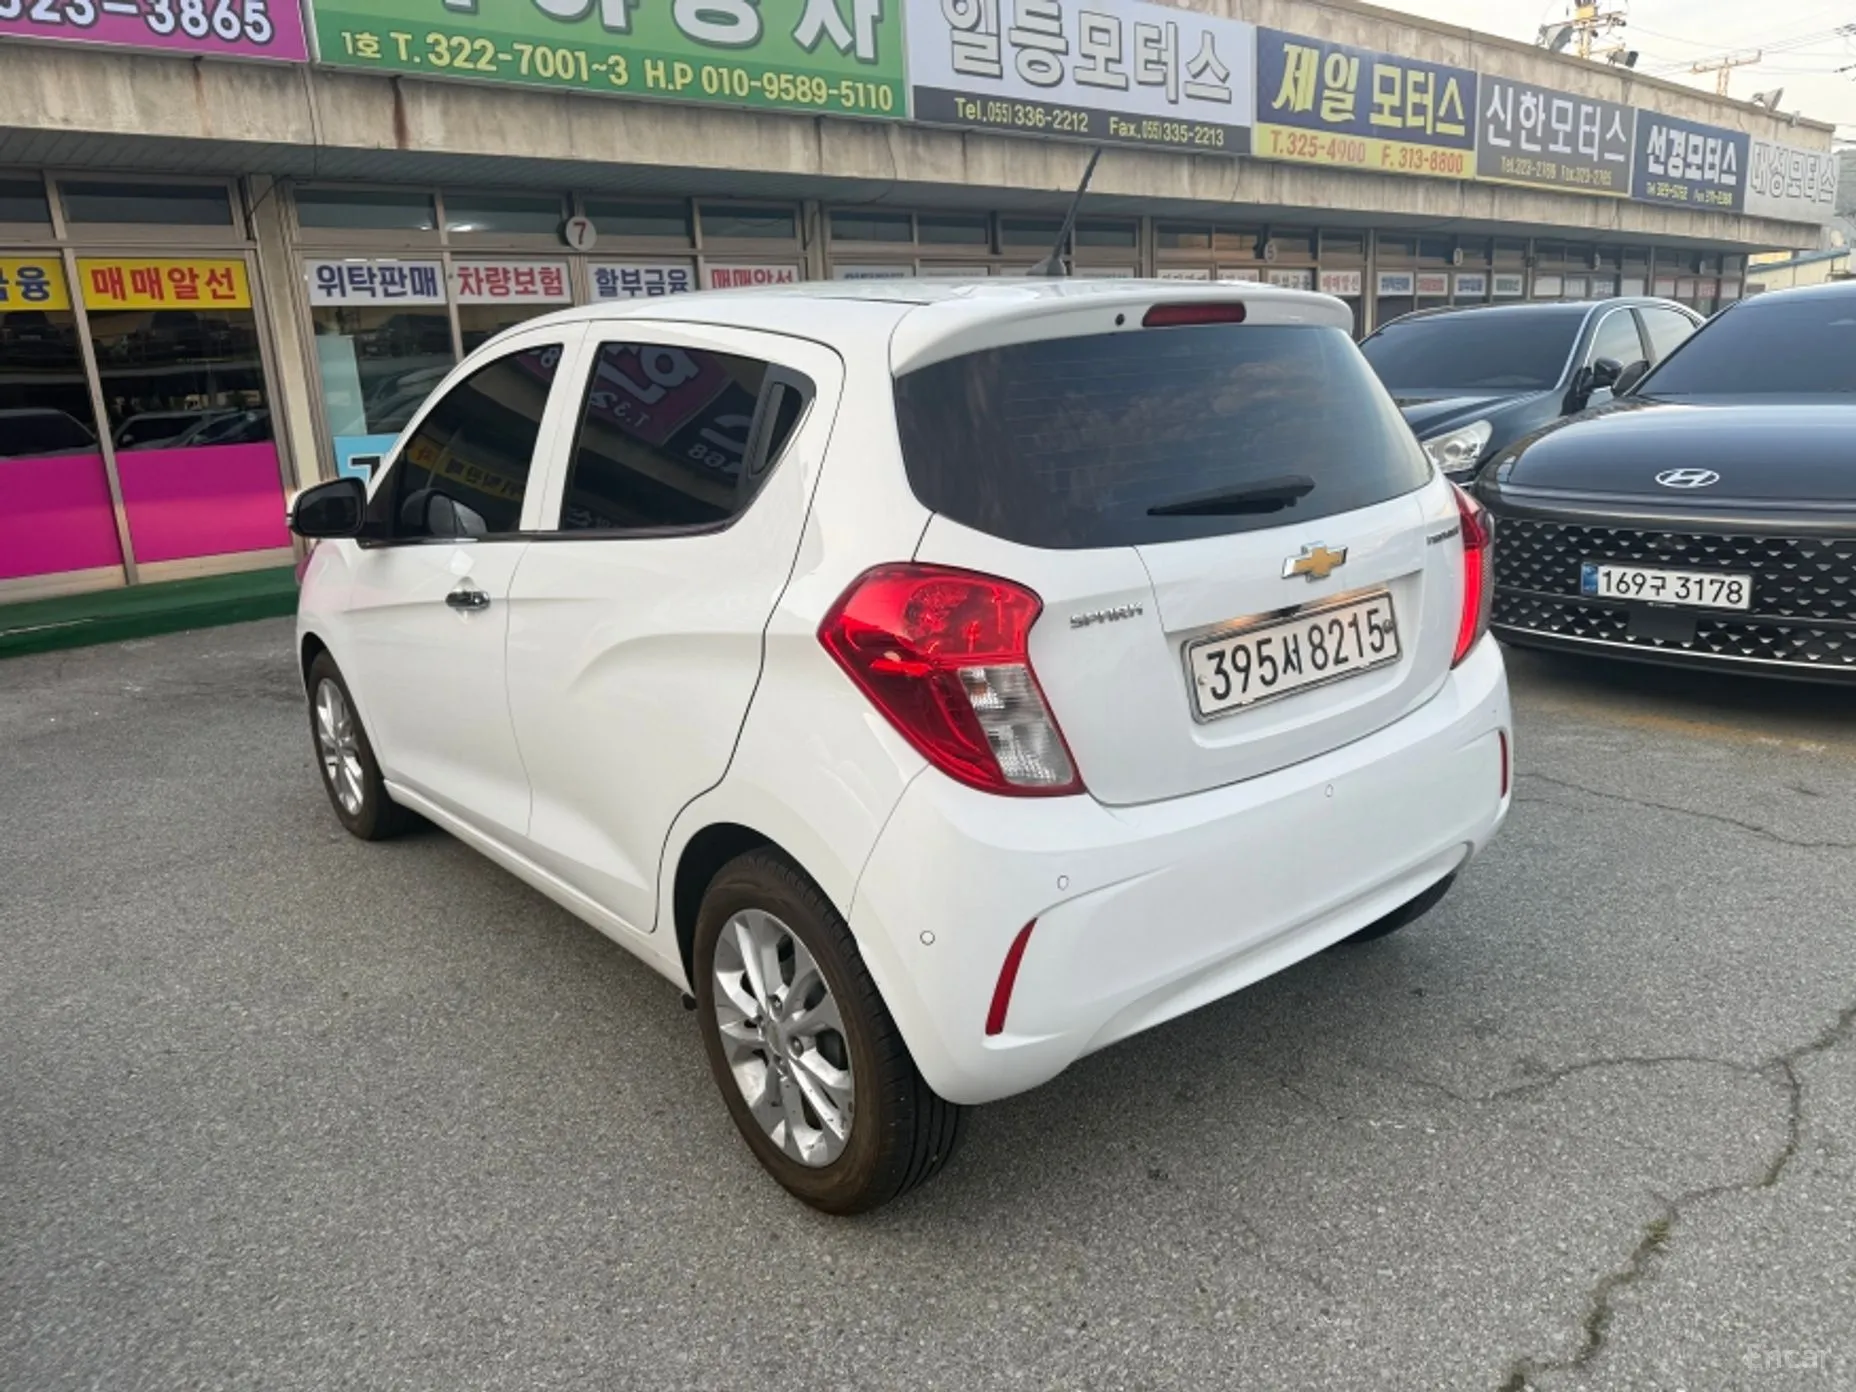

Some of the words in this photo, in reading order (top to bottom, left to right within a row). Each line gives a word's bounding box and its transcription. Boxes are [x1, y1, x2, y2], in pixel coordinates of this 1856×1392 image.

[340, 31, 381, 58] 1호
[644, 58, 694, 91] H.P
[701, 65, 893, 111] 010-9589-5110
[940, 0, 1232, 104] 일등모터스
[1272, 43, 1360, 123] 제일
[1369, 63, 1466, 136] 모터스
[1486, 84, 1627, 162] 신한모터스
[1647, 125, 1738, 185] 선경모터스
[573, 221, 586, 246] 7
[91, 266, 237, 301] 매매알선
[315, 265, 439, 298] 위탁판매
[457, 266, 565, 297] 차량보험
[594, 268, 690, 297] 할부금융
[1603, 570, 1667, 596] 169구
[1675, 576, 1744, 604] 3178
[1206, 634, 1302, 701] 395서
[1310, 608, 1386, 670] 8215
